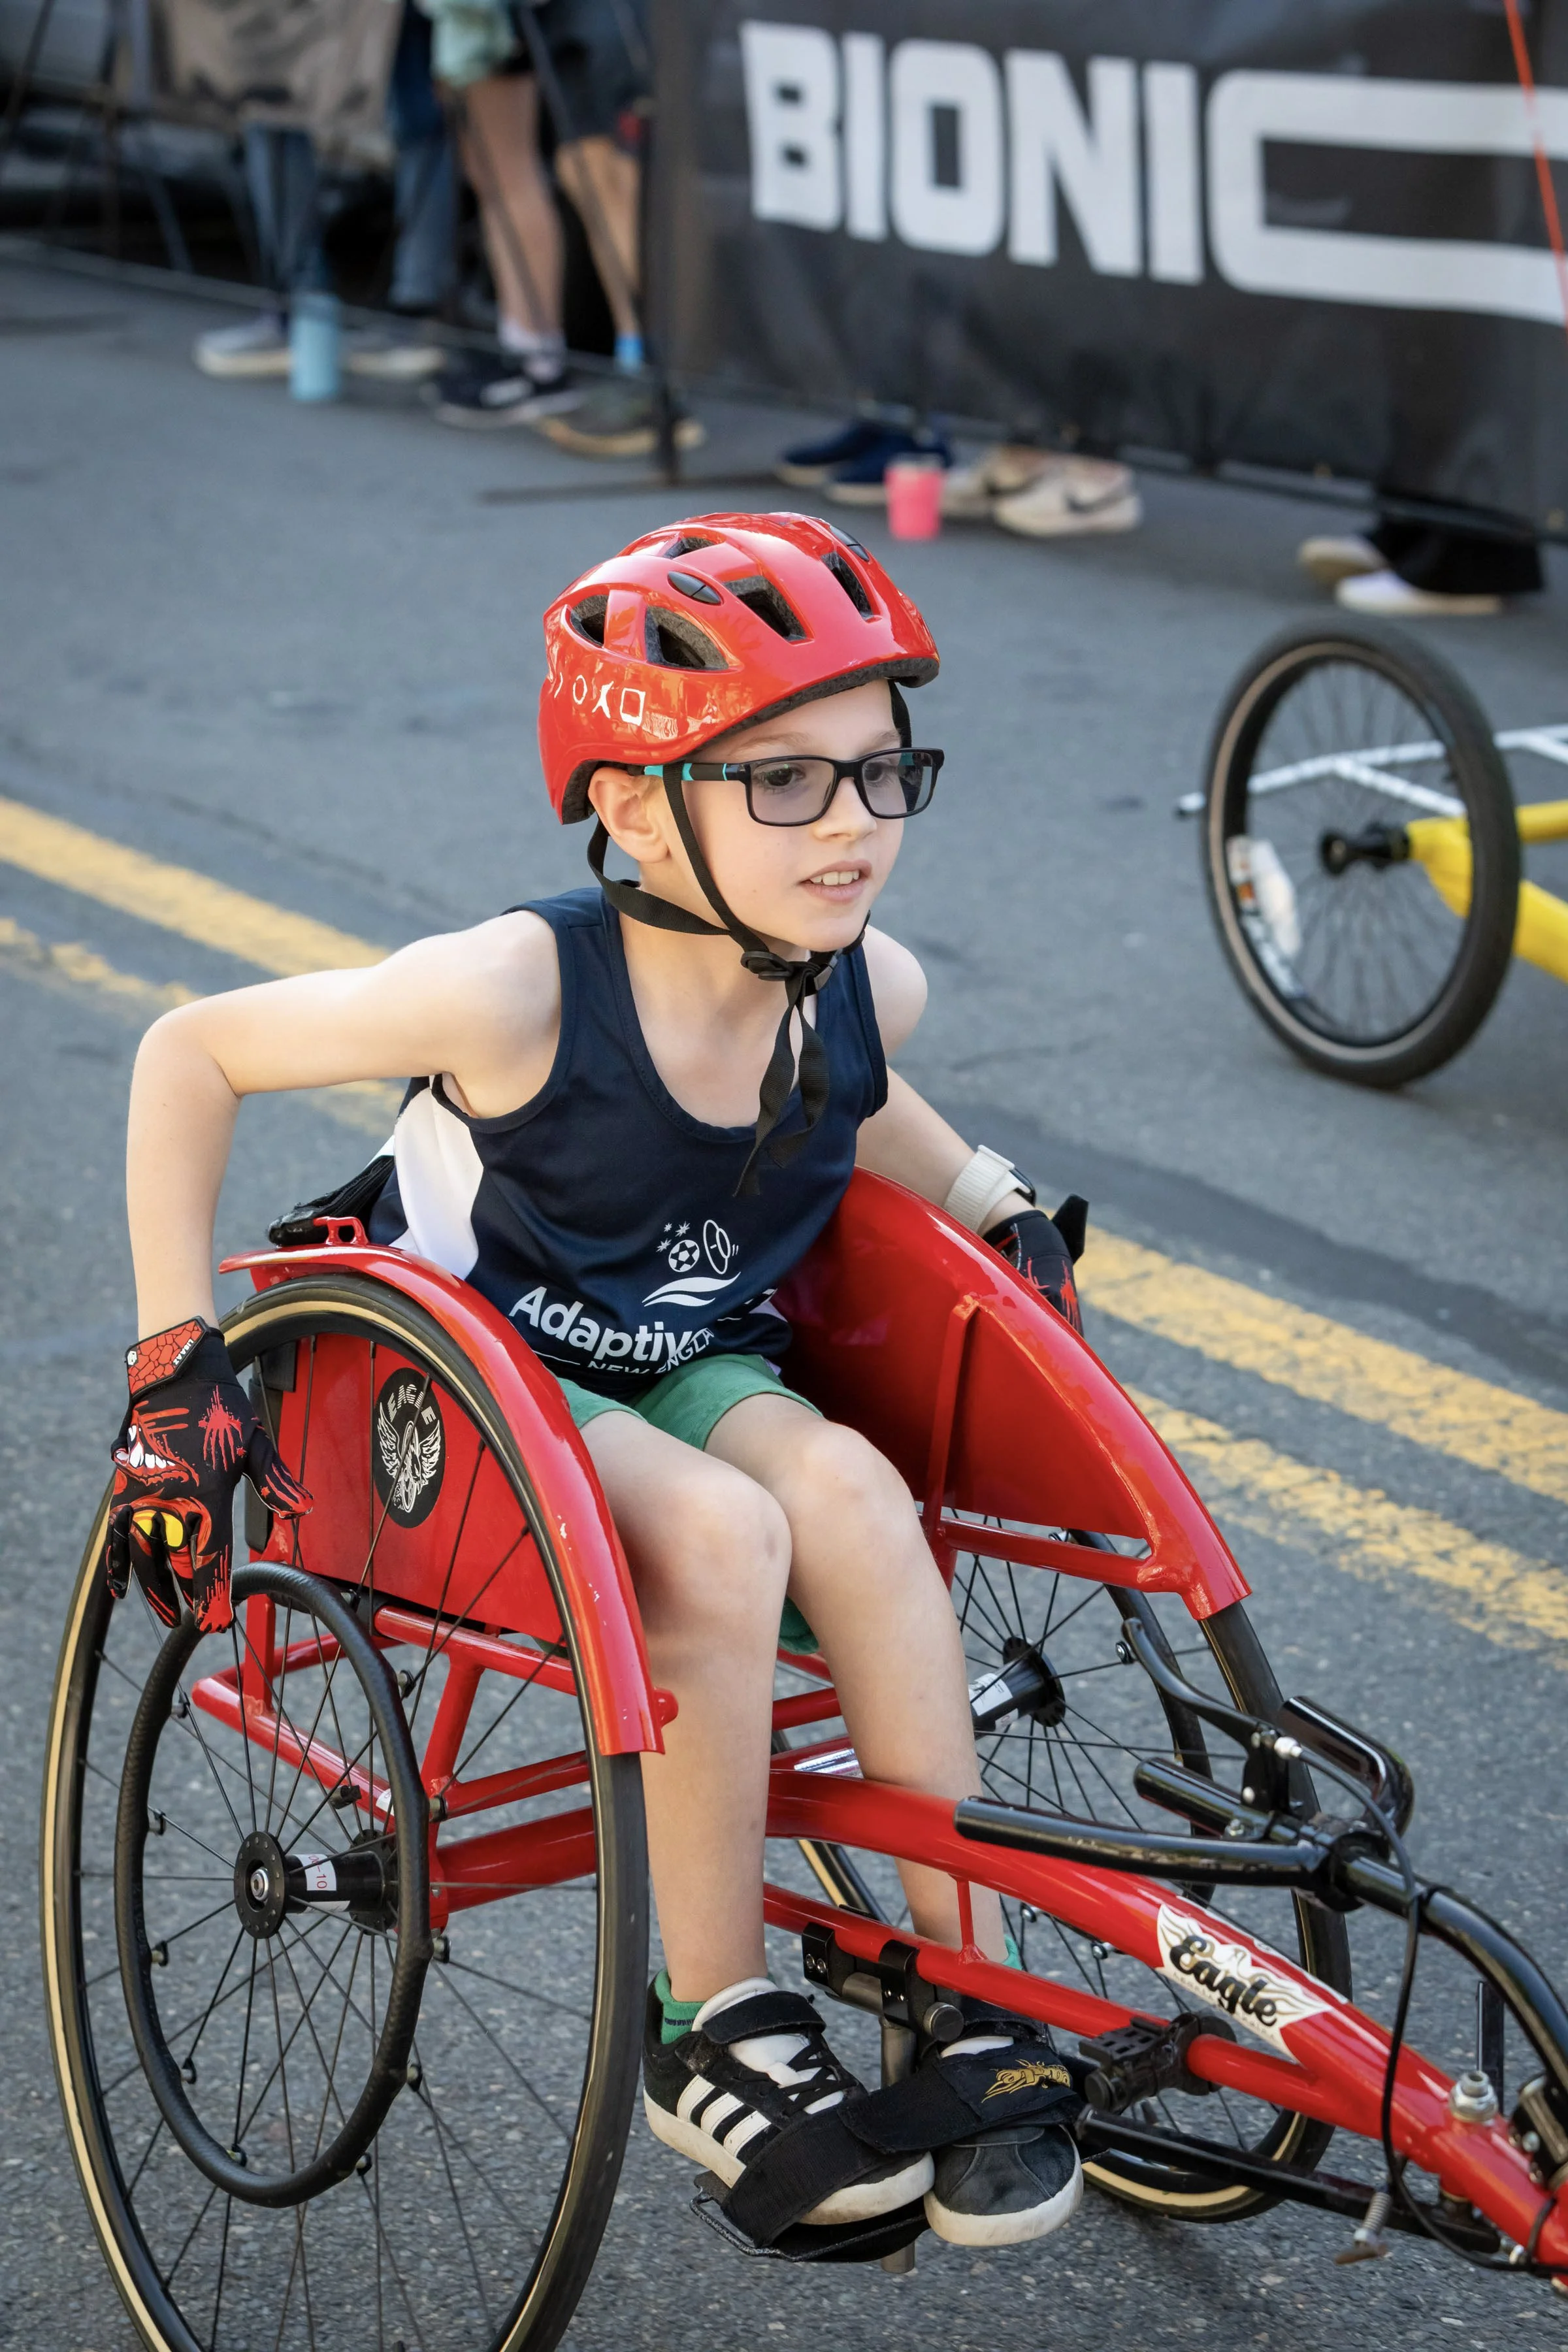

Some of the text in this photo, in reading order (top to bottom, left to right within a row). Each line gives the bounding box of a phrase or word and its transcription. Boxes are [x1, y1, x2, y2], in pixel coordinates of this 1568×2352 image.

[740, 21, 1568, 324] BIONIC
[509, 1286, 693, 1361] Adaptiv
[587, 1328, 714, 1374] NEW ENGLA
[1169, 1935, 1277, 2026] Eagle
